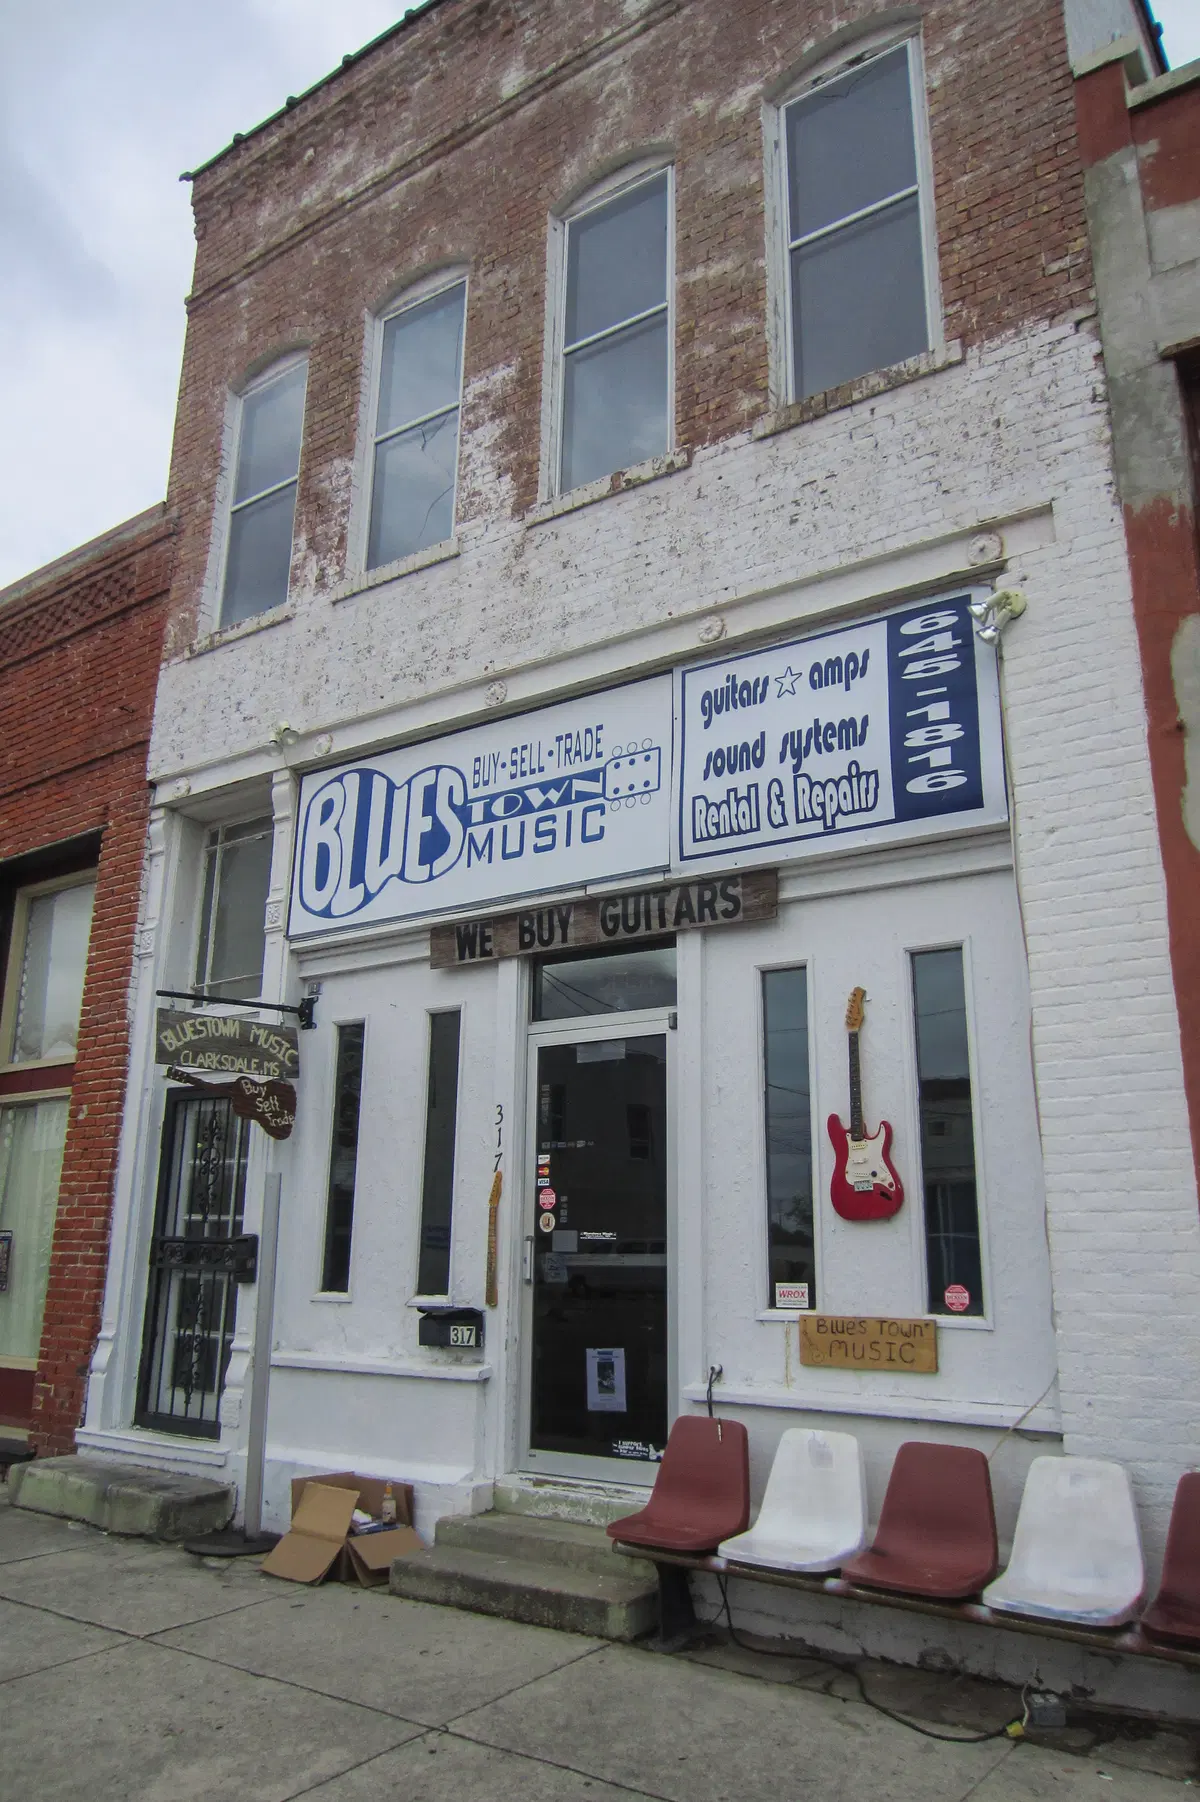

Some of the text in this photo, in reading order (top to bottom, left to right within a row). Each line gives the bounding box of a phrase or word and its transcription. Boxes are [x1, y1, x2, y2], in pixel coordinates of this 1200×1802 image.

[701, 649, 869, 729] guitars amps
[898, 610, 969, 794] 645-1816
[704, 714, 869, 781] sound systems
[692, 760, 880, 843] Rental & Repairs
[300, 764, 604, 918] BLUES TOWN
[466, 803, 606, 868] MUSIC
[455, 878, 742, 961] WE BUY GUITARS
[160, 1017, 298, 1067] BLUESTOWN MUSIC
[241, 1079, 267, 1097] Buy
[256, 1096, 280, 1112] Sell
[265, 1111, 295, 1126] Trade
[779, 1290, 806, 1298] WROX
[451, 1327, 475, 1345] 317
